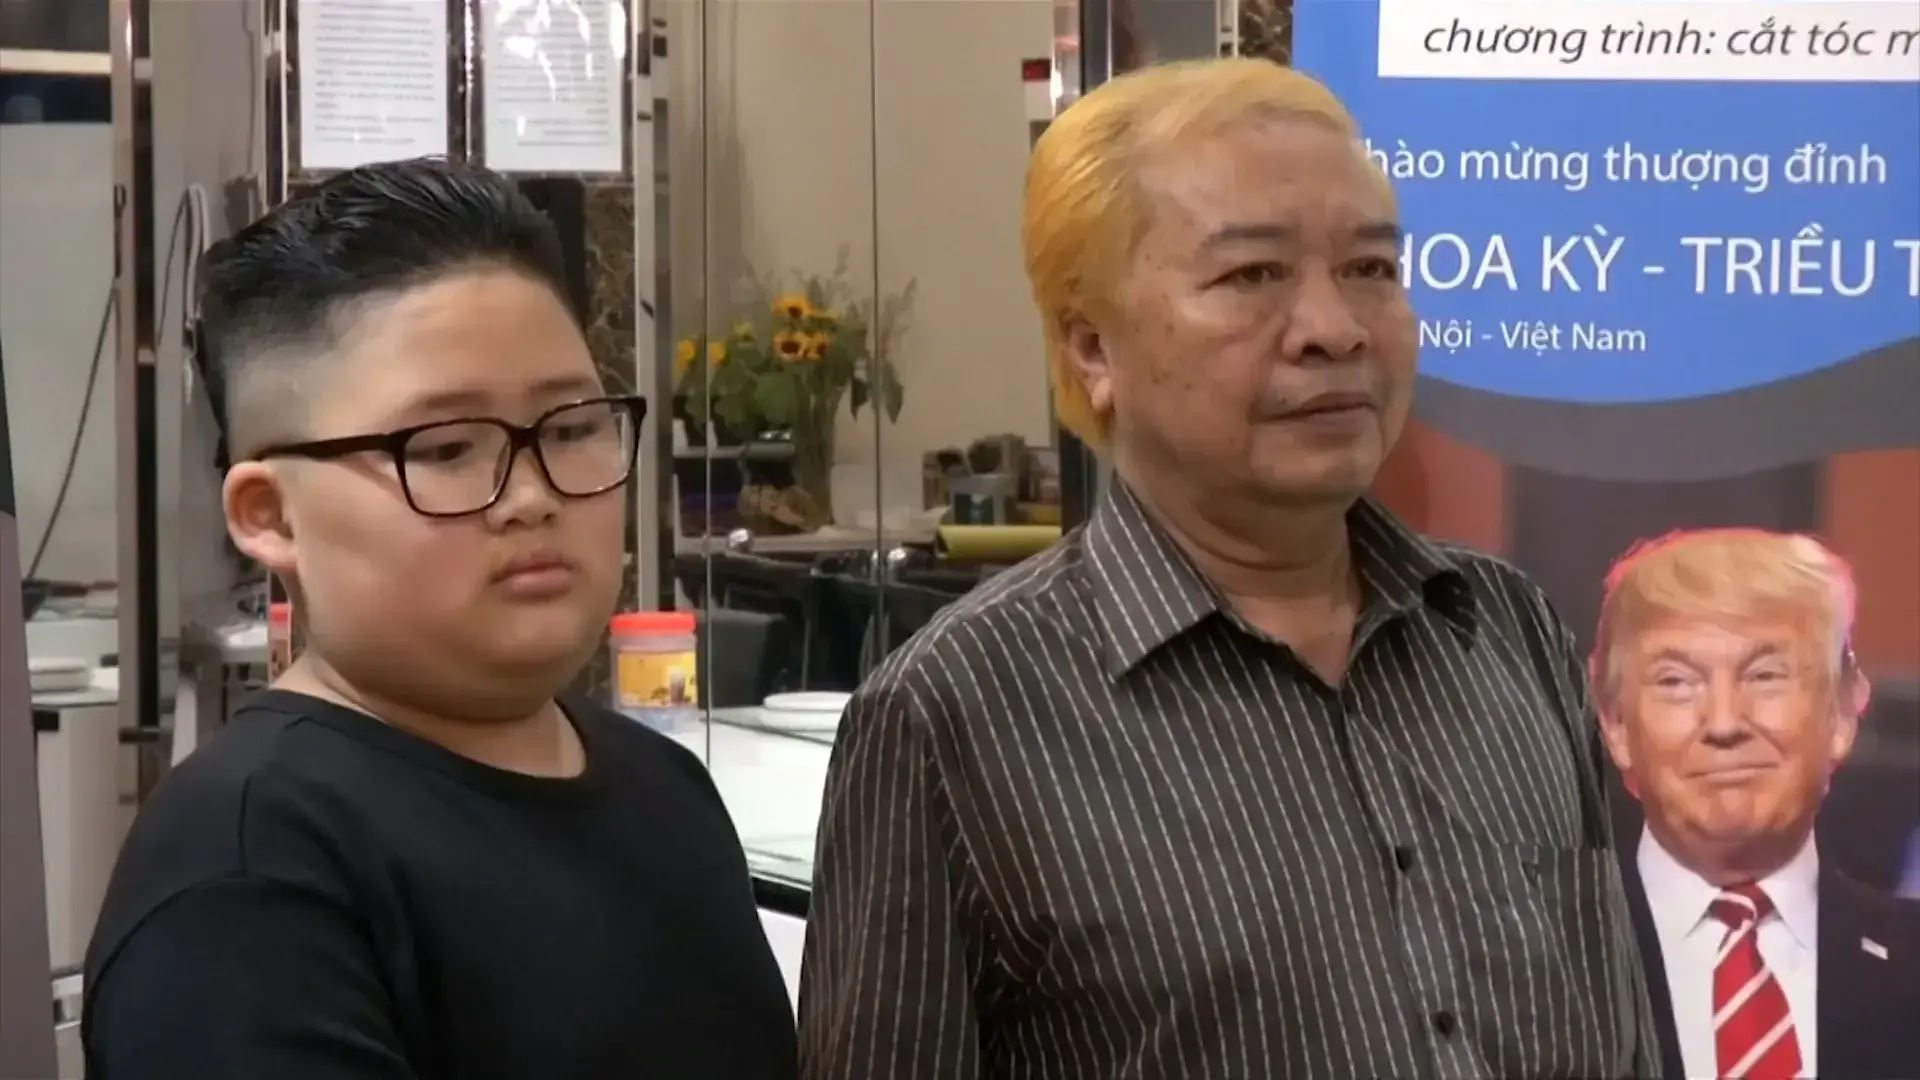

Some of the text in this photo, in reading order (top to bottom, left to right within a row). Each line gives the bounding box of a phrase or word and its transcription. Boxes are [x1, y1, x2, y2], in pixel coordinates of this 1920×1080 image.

[1423, 17, 1588, 64] chương
[1600, 19, 1716, 55] trình:
[1726, 15, 1797, 56] cắt
[1807, 20, 1876, 56] tóc
[1365, 137, 1887, 193] hào mừng thượng đỉnh
[1541, 223, 1626, 292] KỲ
[1680, 221, 1876, 296] TRIỀU
[1418, 319, 1472, 355] Nội
[1499, 319, 1563, 357] Việt
[1572, 320, 1646, 351] Nam
